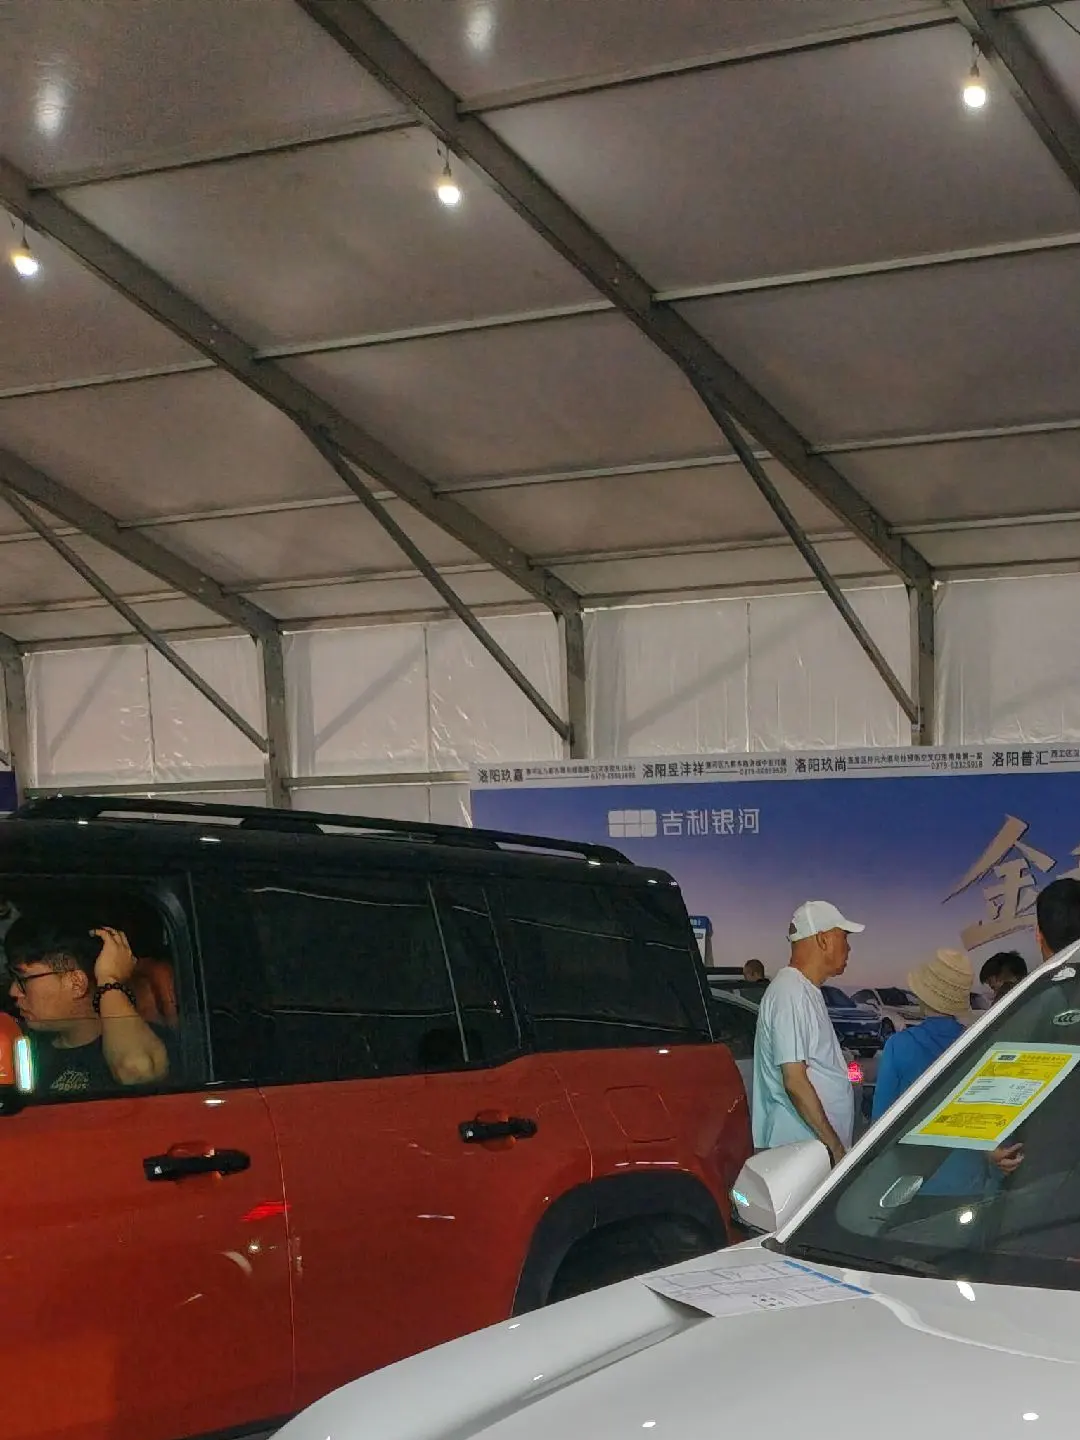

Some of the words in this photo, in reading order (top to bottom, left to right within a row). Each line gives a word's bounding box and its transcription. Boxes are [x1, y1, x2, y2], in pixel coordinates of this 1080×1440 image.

[992, 751, 1049, 767] 洛阳普汇
[661, 809, 760, 836] 吉利银河
